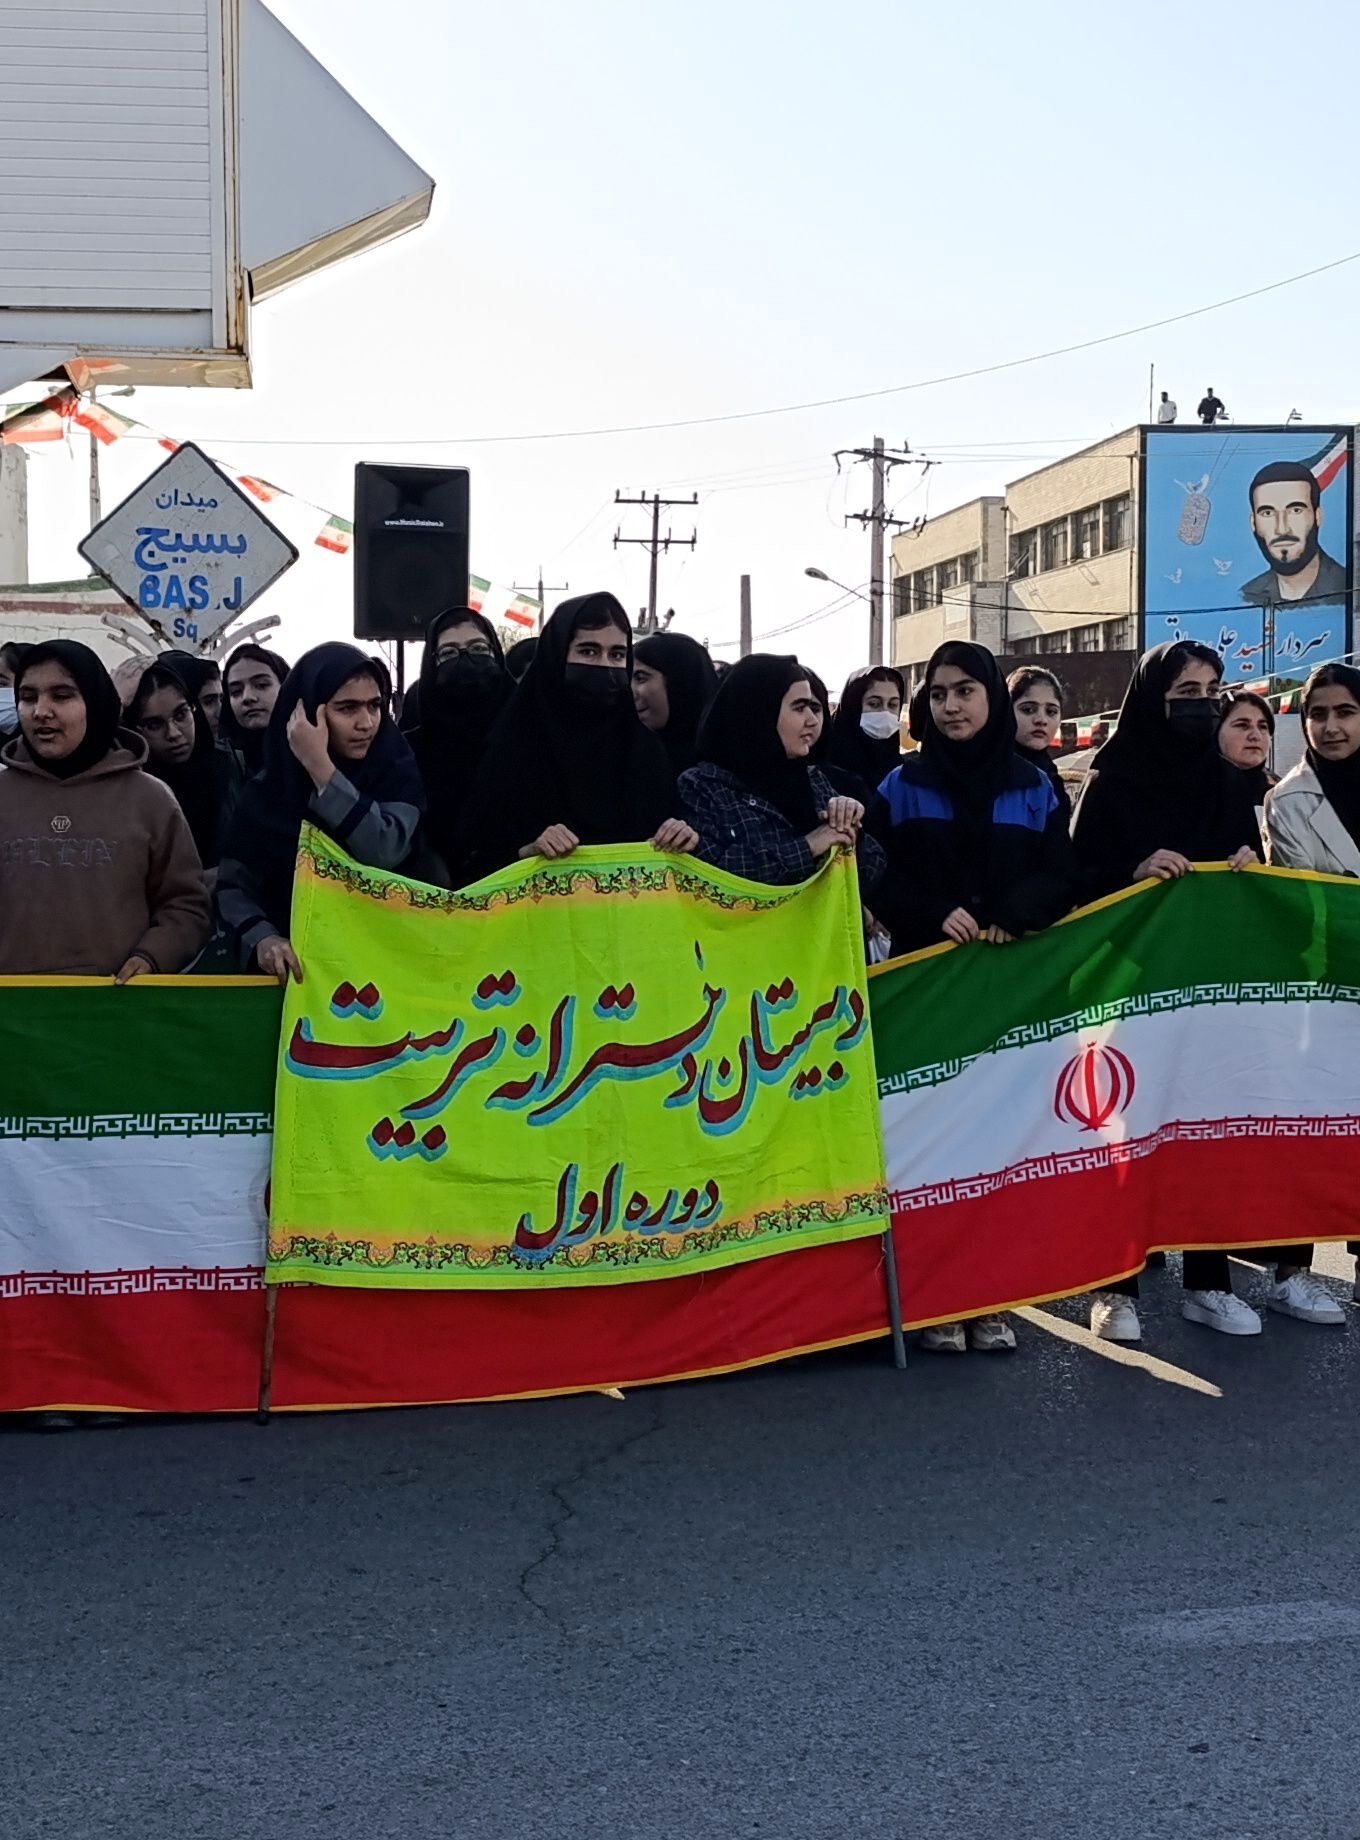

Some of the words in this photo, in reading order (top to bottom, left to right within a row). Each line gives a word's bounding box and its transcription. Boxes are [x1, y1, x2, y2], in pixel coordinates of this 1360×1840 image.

[155, 488, 218, 513] میدان
[134, 526, 248, 572] بسیج
[139, 574, 242, 610] BASJ
[172, 618, 198, 643] Sq
[1276, 630, 1331, 661] سردار
[285, 969, 522, 1161] تربیت
[696, 976, 870, 1136] دبیستان
[513, 1161, 624, 1256] اول
[621, 1178, 723, 1235] دوره
